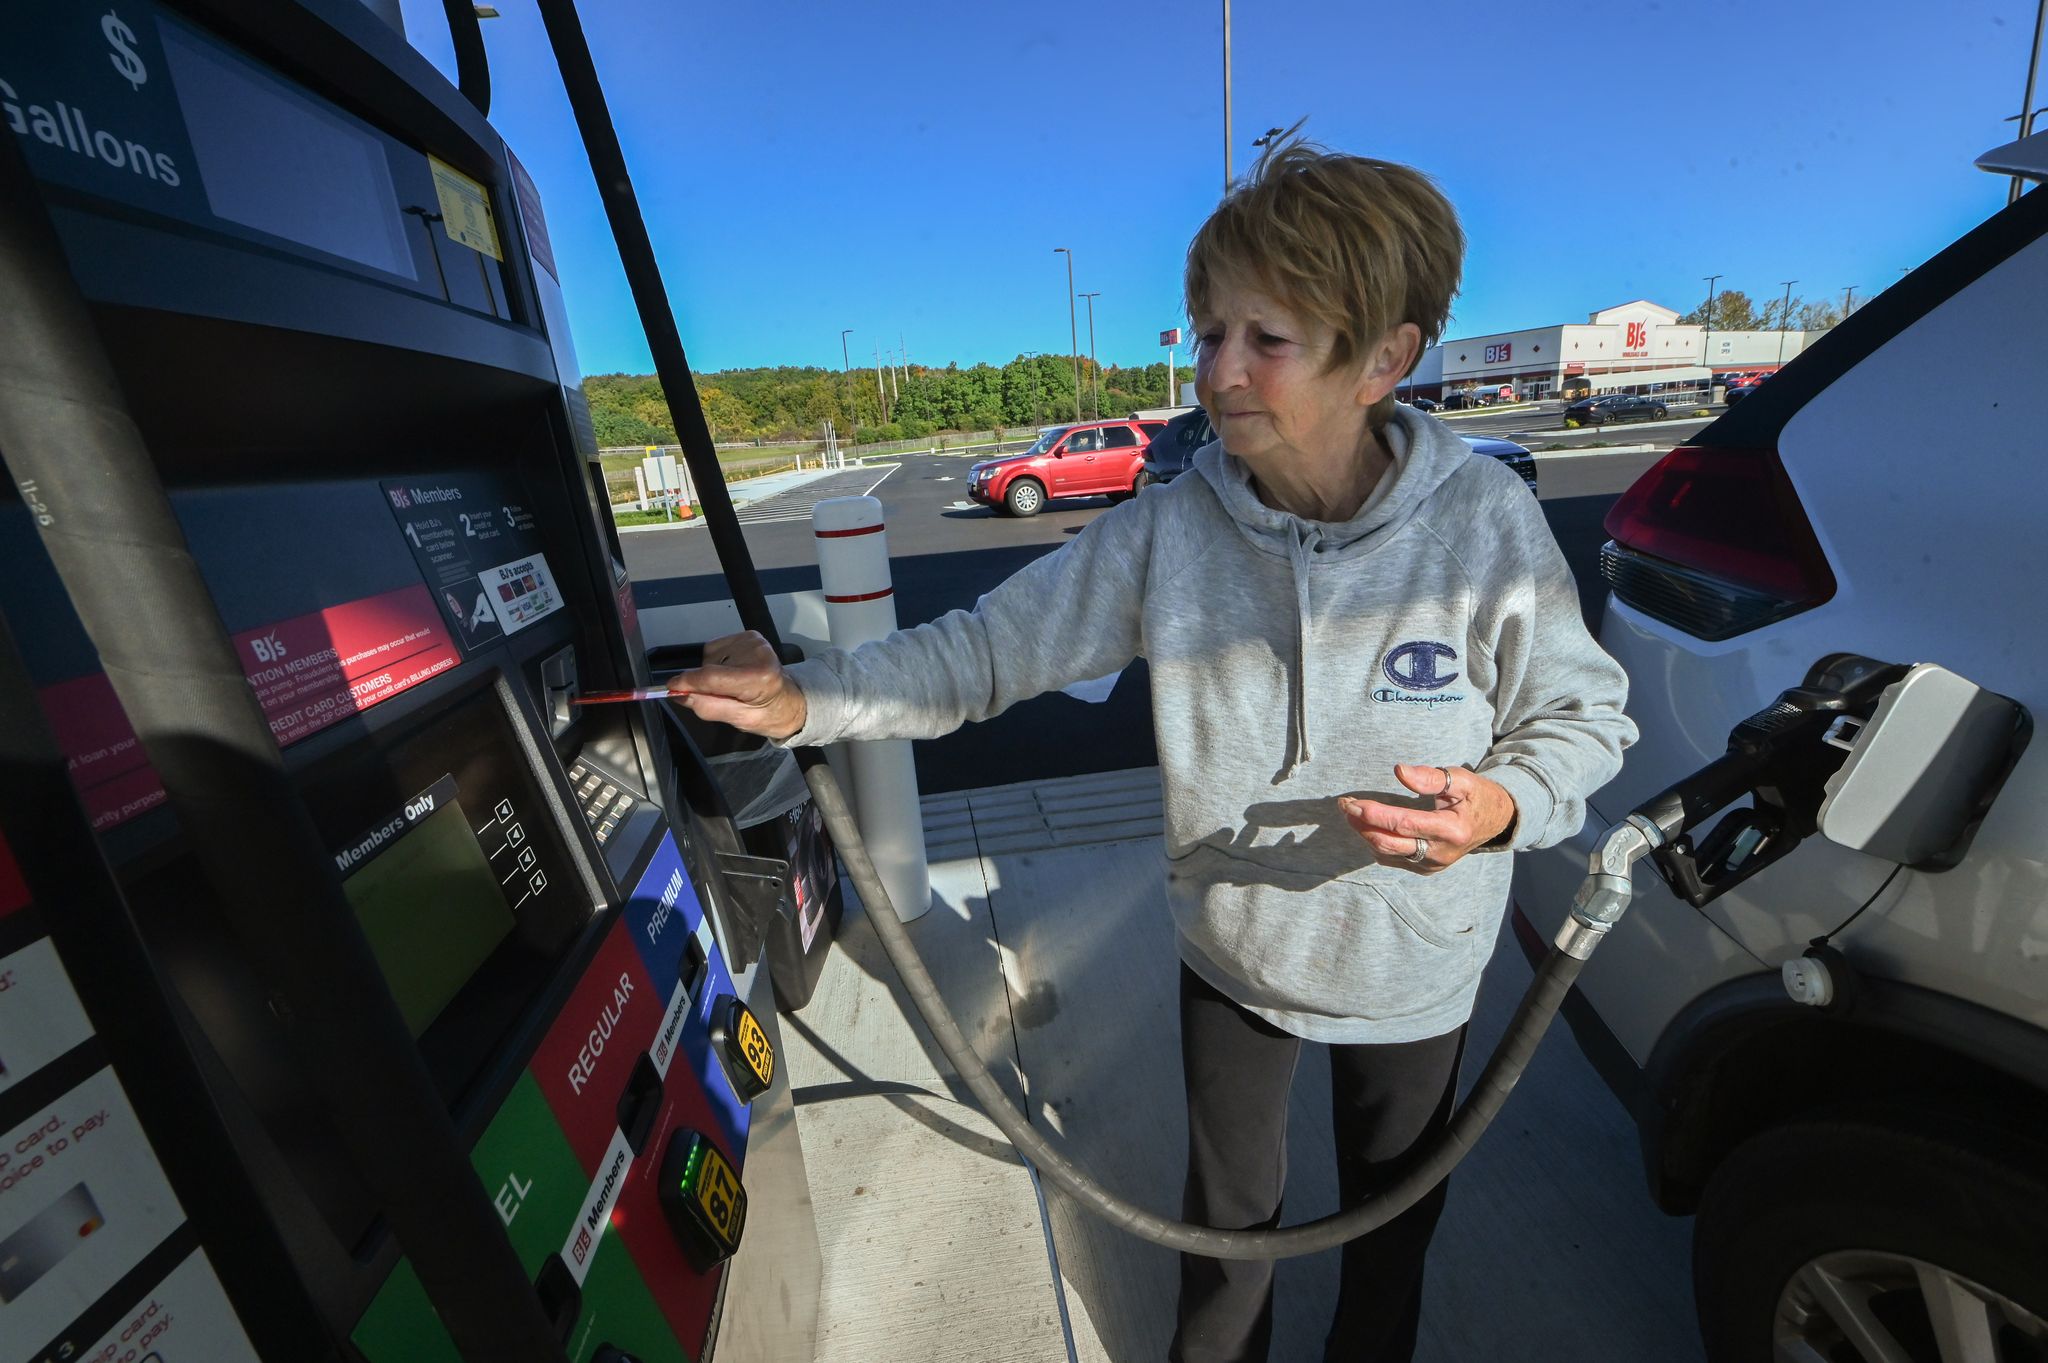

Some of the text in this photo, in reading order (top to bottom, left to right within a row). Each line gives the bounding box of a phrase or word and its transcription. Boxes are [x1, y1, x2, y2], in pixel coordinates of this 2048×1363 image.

[101, 9, 148, 92] $
[0, 78, 181, 187] Gallons
[1626, 317, 1648, 351] BJ's
[1486, 344, 1509, 363] BJ's
[389, 485, 462, 509] BJ's Members
[405, 522, 422, 548] 1
[415, 518, 443, 530] Hold BJ's
[421, 529, 455, 541] membership
[459, 513, 476, 537] 2
[503, 506, 516, 528] 3
[426, 540, 456, 552] card below
[499, 561, 534, 580] BJ's accepts
[250, 628, 287, 662] BJ's
[270, 680, 295, 694] pump.
[295, 664, 334, 683] Fraudulent
[333, 659, 347, 671] gas
[346, 647, 377, 665] purchases
[377, 643, 391, 652] may
[390, 639, 405, 649] occur
[405, 633, 417, 642] that
[416, 628, 431, 638] would
[284, 648, 338, 675] MEMBERS
[267, 697, 278, 707] on
[278, 691, 295, 704] your
[297, 673, 341, 695] membership.
[277, 657, 454, 743] to enter the ZIP CODE of your credit card's BILLING ADDRESS
[305, 697, 335, 718] CARD
[336, 673, 392, 704] CUSTOMERS
[1370, 690, 1463, 711] Champion
[79, 748, 108, 764] loan
[110, 737, 136, 756] your
[335, 794, 435, 871] Members Only
[646, 868, 684, 945] PREMIUM
[567, 972, 635, 1096] REGULAR
[656, 996, 686, 1066] BJ's Members
[748, 1027, 764, 1069] 93
[15, 1115, 66, 1154] card.
[46, 1138, 68, 1156] to
[72, 1110, 110, 1142] pay.
[494, 1171, 533, 1227] EL
[572, 1149, 626, 1266] BJ's Members
[710, 1164, 734, 1229] 87
[121, 1300, 163, 1341] card.
[141, 1313, 173, 1350] pay.
